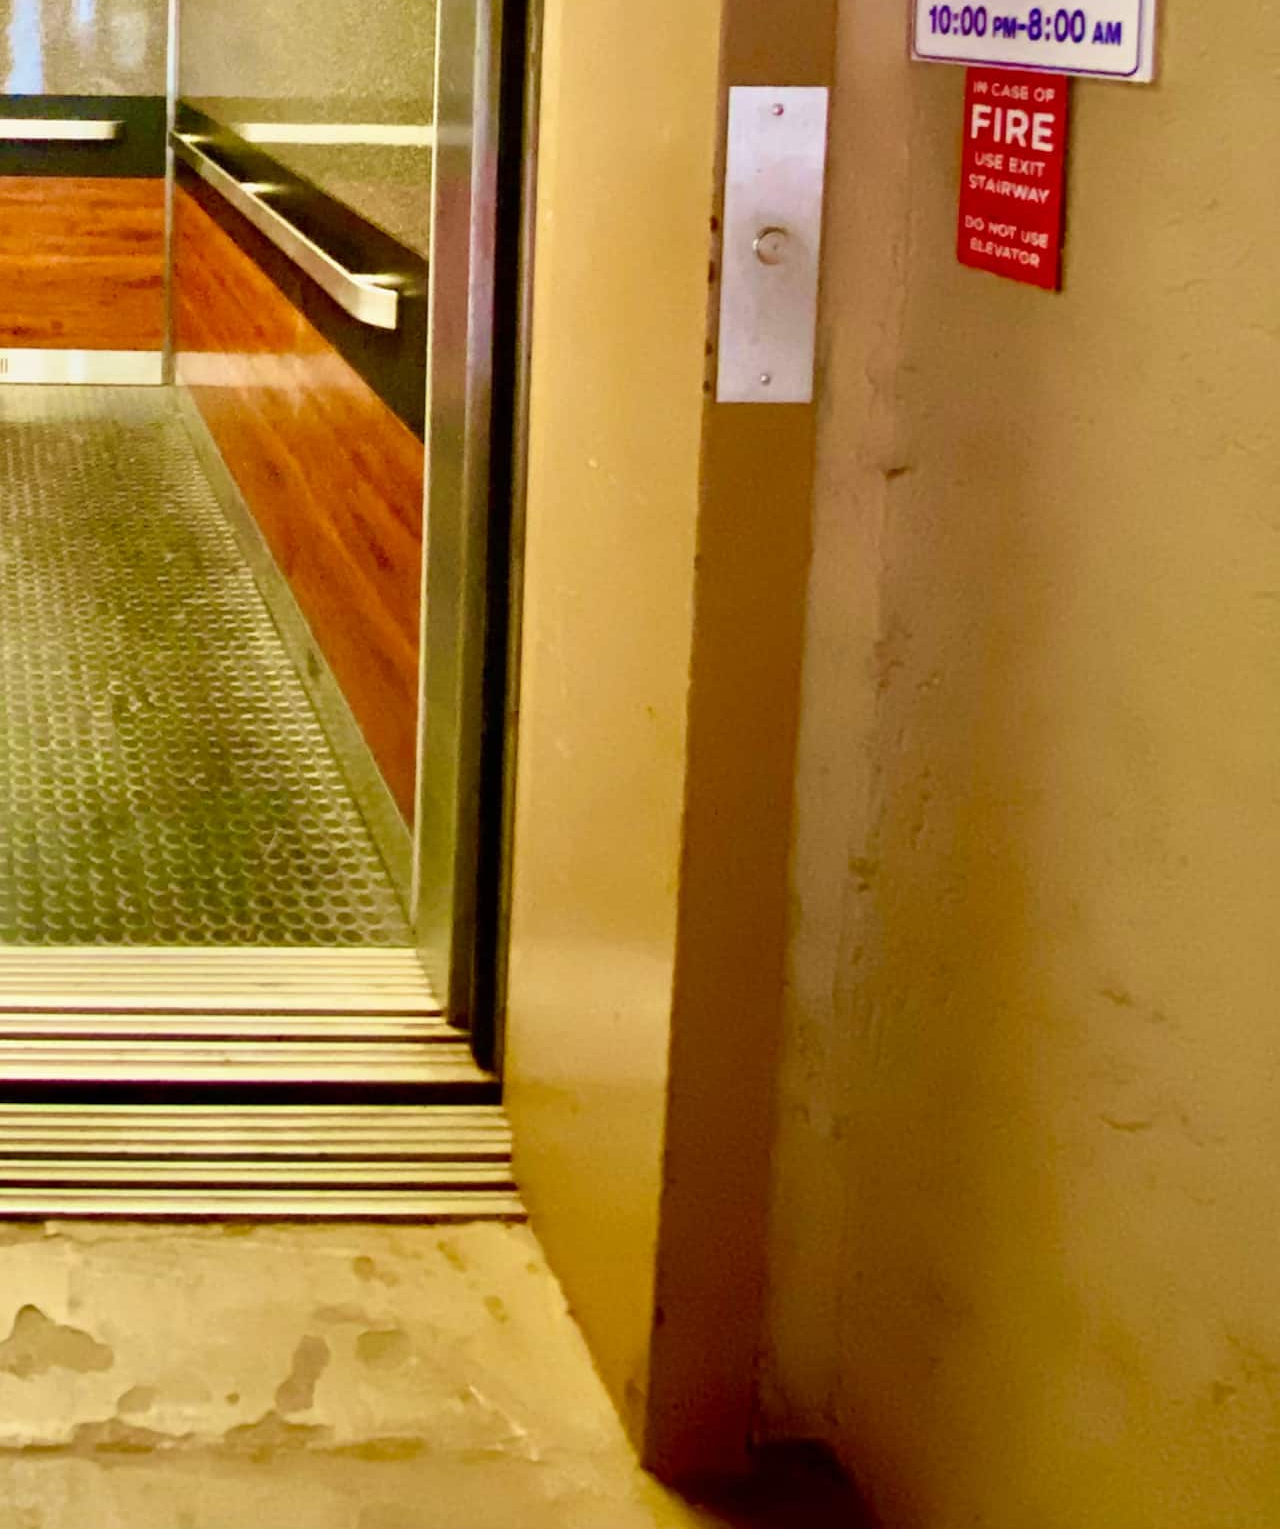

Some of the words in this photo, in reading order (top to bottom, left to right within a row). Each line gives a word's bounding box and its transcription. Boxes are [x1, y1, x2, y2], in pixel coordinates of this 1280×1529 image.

[929, 4, 987, 38] 10:00
[1091, 21, 1123, 46] AM
[973, 80, 988, 95] IN
[991, 82, 1029, 101] CASE
[1033, 86, 1056, 103] OF
[970, 103, 1055, 153] FIRE
[975, 151, 1004, 171] USE
[1008, 156, 1046, 178] EXIT
[968, 173, 1051, 205] STAIRWAY
[964, 214, 985, 231] DO
[988, 222, 1017, 240] NOT
[1021, 230, 1049, 249] USE
[969, 236, 1041, 269] ELEVATOR
